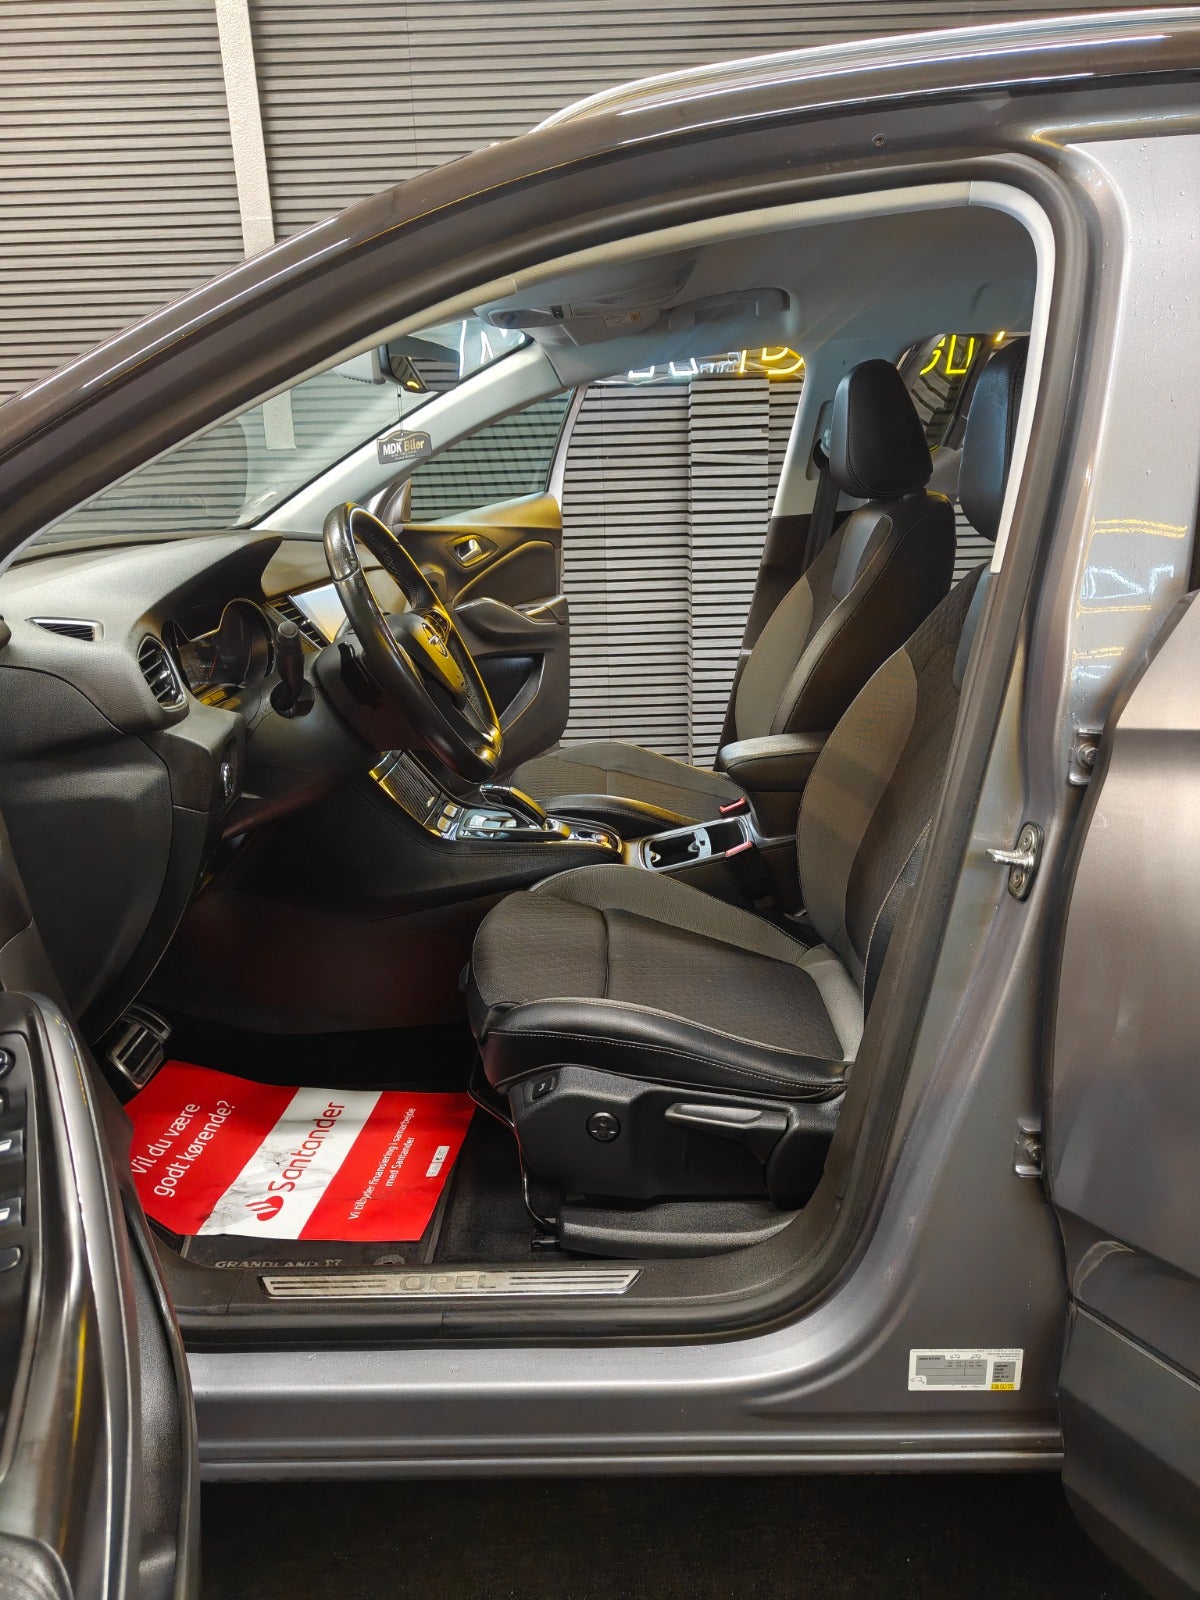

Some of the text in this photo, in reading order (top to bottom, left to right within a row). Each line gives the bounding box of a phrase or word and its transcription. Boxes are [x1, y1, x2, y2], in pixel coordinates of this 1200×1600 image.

[383, 441, 402, 456] MDK
[404, 438, 425, 452] Biler
[131, 1103, 201, 1174] Vil du være
[393, 1107, 416, 1143] samarbejde
[153, 1100, 236, 1198] godt kørende?
[268, 1102, 346, 1193] Santander
[368, 1145, 399, 1186] finansiering
[385, 1136, 416, 1187] med Santander
[353, 1184, 375, 1210] tilbyder
[347, 1211, 361, 1220] Vi
[214, 1259, 319, 1269] GRANDLAND
[399, 1274, 497, 1291] OPEL
